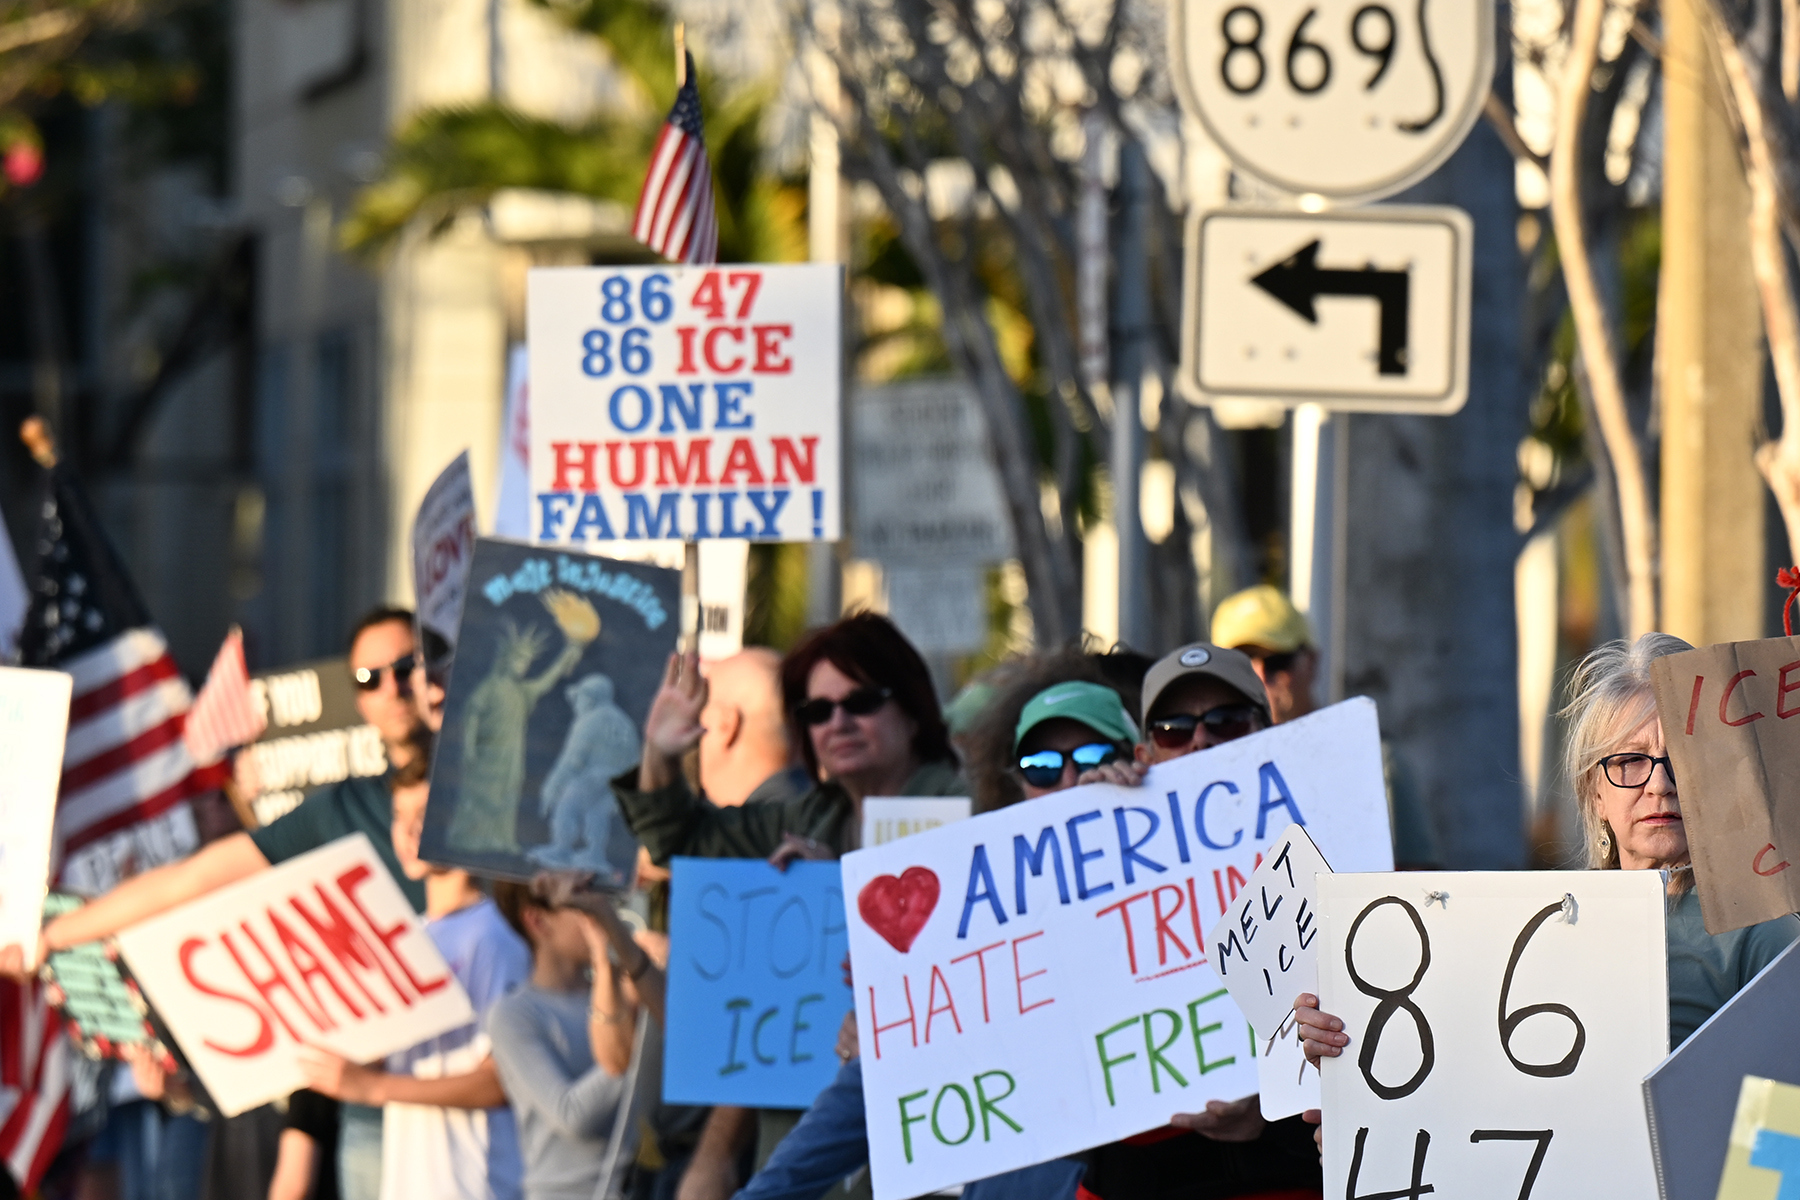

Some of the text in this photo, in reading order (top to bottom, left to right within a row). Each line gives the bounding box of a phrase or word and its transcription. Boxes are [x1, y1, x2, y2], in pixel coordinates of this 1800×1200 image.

[1221, 5, 1398, 94] 869
[600, 271, 763, 325] 86 47
[581, 324, 793, 378] 86 ICE
[608, 381, 754, 434] ONE
[551, 436, 820, 492] HUMAN
[956, 760, 1308, 940] AMERICA
[690, 881, 848, 982] STOP
[1216, 840, 1295, 976] MELT
[1262, 897, 1318, 996] ICE
[178, 863, 449, 1059] SHAME
[868, 931, 1055, 1060] HATE
[1344, 895, 1587, 1101] 86
[718, 992, 826, 1077] ICE
[897, 1069, 1025, 1165] FOR
[1094, 988, 1257, 1107] FRE
